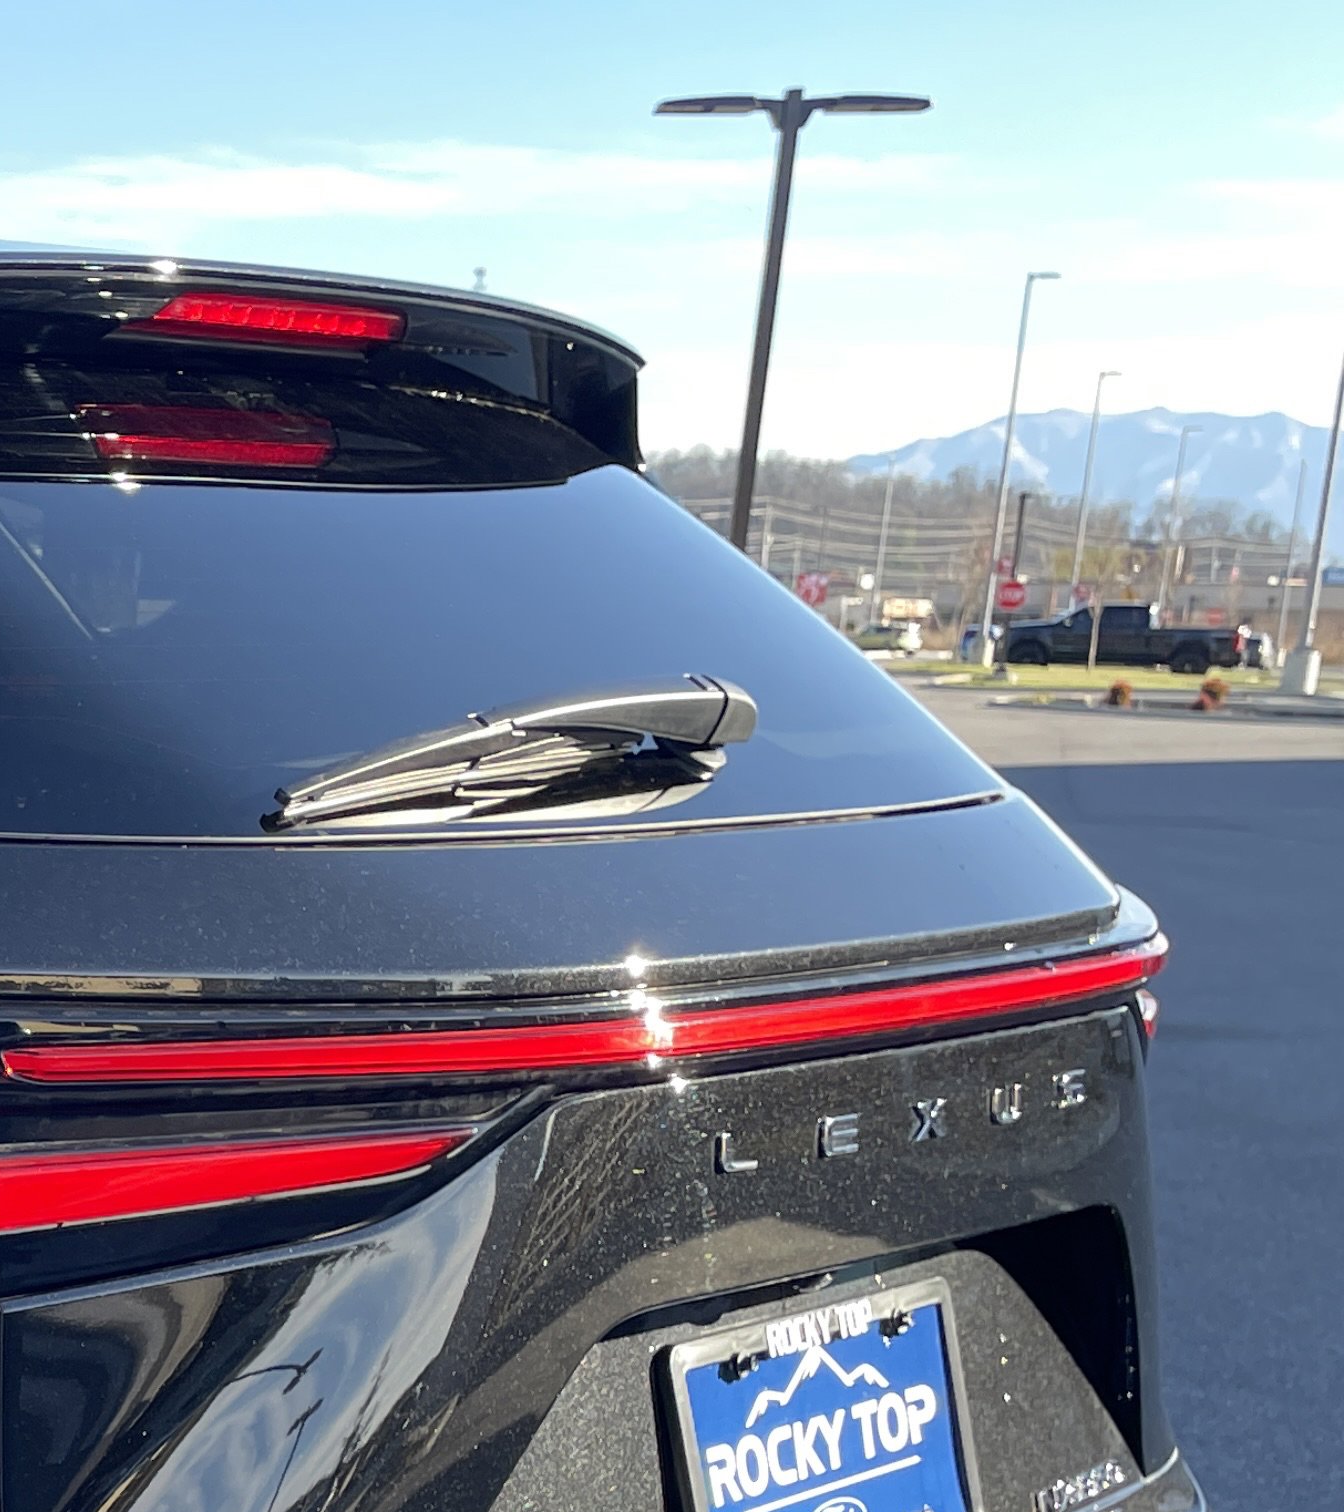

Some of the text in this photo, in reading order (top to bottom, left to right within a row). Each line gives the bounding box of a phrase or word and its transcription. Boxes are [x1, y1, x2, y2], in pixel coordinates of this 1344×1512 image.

[715, 1068, 1087, 1173] LEXUS
[766, 1298, 873, 1358] ROCKY TOP
[706, 1384, 937, 1509] ROCKY TOP
